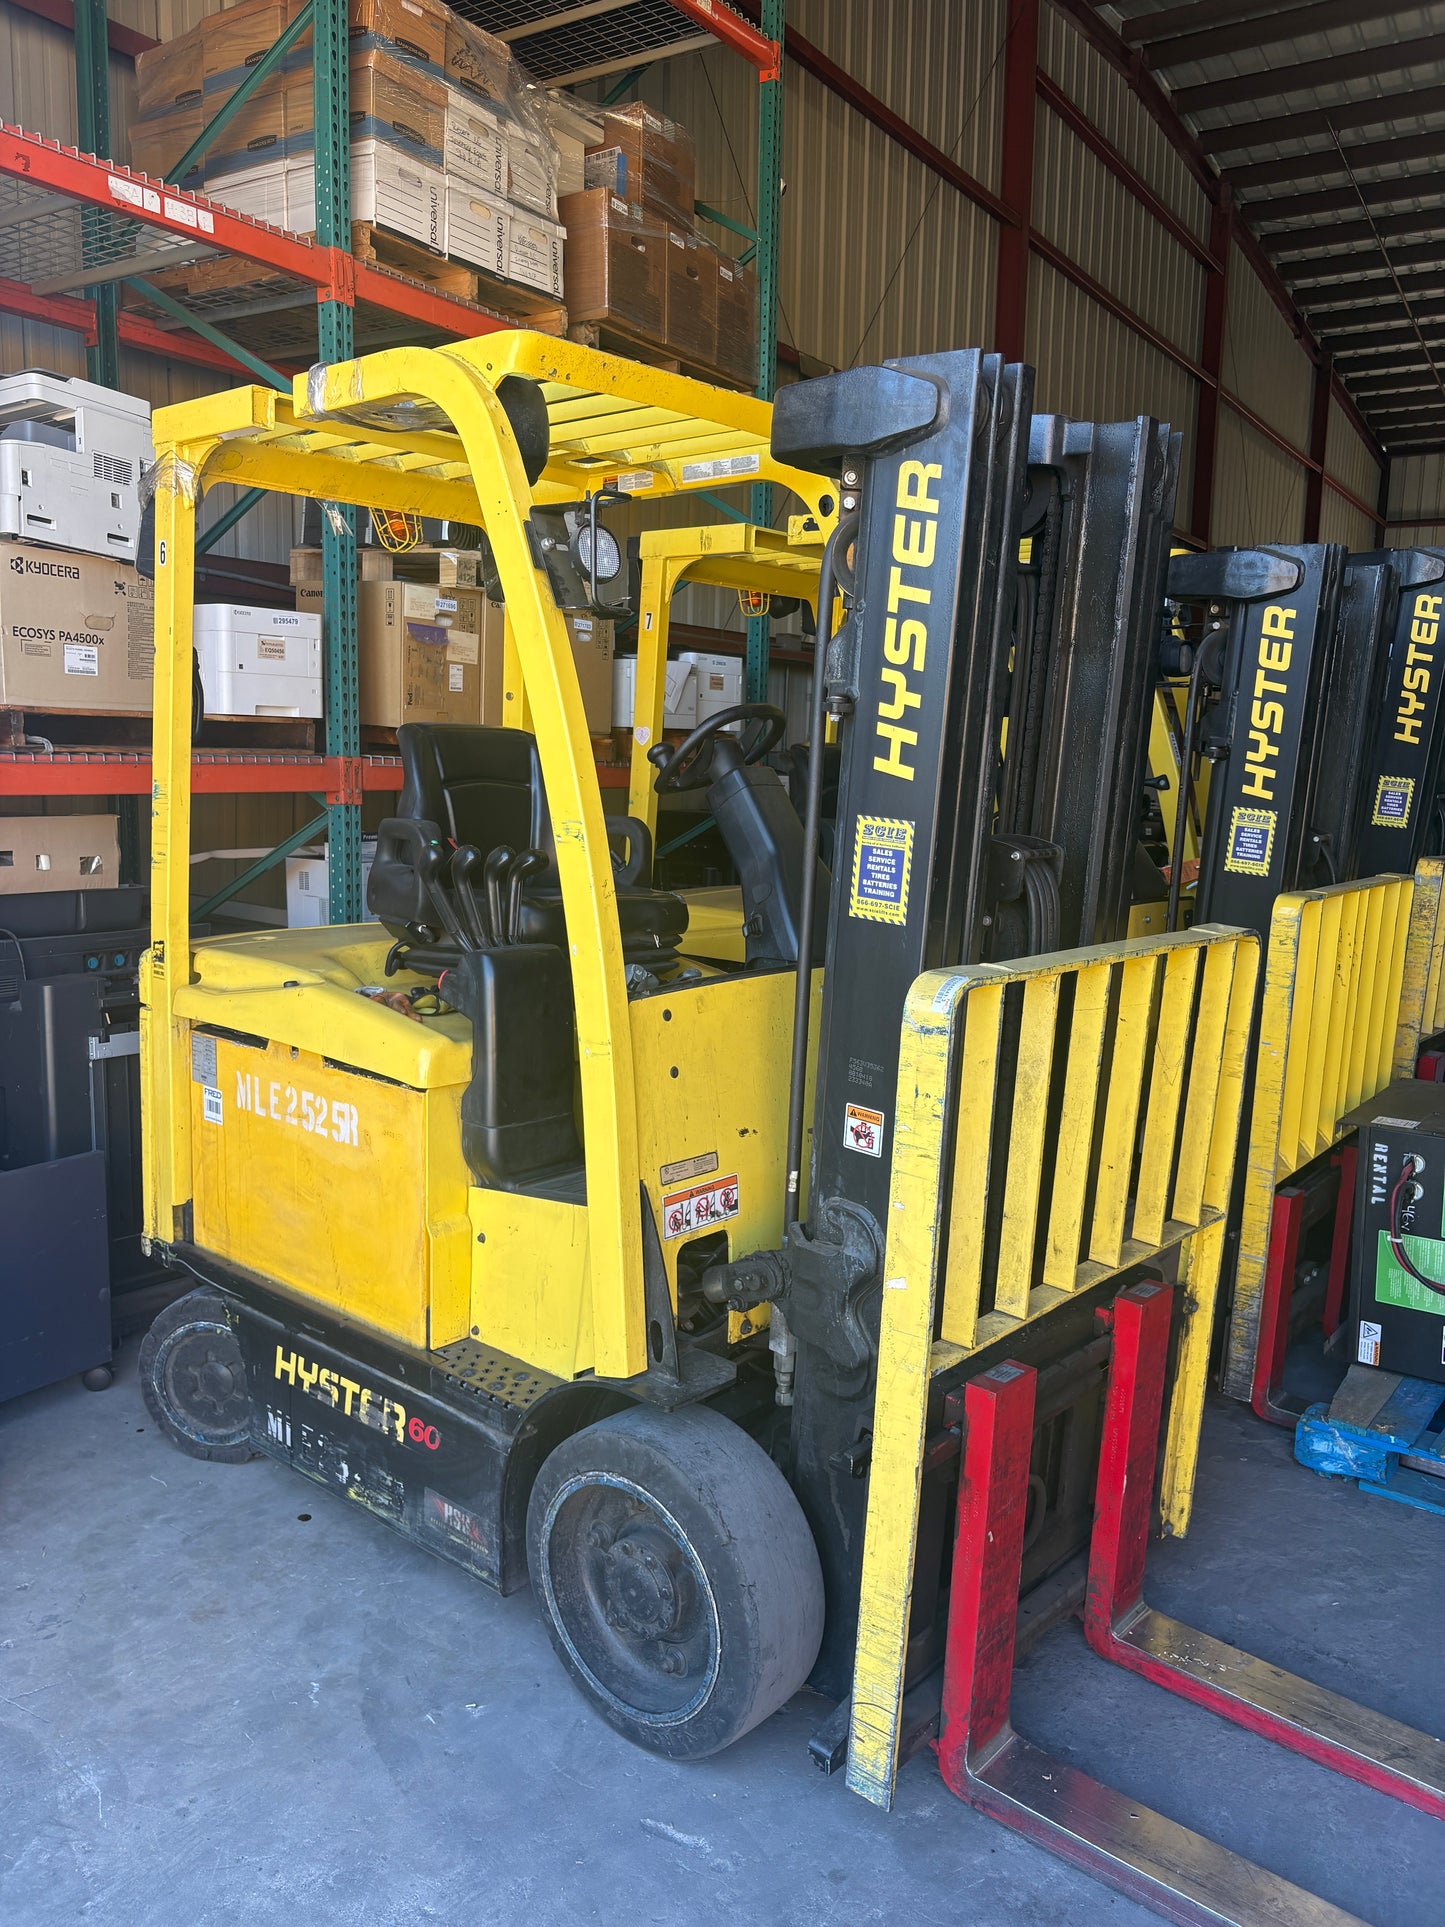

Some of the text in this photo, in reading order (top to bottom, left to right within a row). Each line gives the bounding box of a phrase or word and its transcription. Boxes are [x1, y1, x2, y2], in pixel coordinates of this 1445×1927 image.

[494, 137, 503, 194] universal
[545, 166, 553, 216] universa
[429, 186, 439, 246] universal
[496, 216, 505, 273] universal
[552, 241, 561, 297] universal
[159, 541, 166, 565] 6
[25, 559, 80, 580] KYOCERA
[278, 617, 299, 625] 295479
[645, 613, 652, 630] 7
[872, 460, 943, 781] HYSTER
[12, 626, 105, 646] ECOSYS PA4500x
[1393, 594, 1443, 745] HYSTER
[1241, 605, 1297, 800] HYSTER
[1238, 812, 1271, 823] SCIE
[863, 823, 907, 840] SCIE
[868, 856, 897, 865] SERVICE
[872, 848, 893, 857] SALES
[1236, 852, 1261, 860] TRAINING
[866, 864, 896, 873] RENTALS
[871, 872, 890, 881] TIRES
[862, 879, 898, 890] BATTERIES
[863, 887, 895, 898] TRAINING
[856, 898, 900, 911] 866-697-SCIE
[204, 1087, 222, 1100] FRED
[857, 1111, 880, 1122] WARNING
[1371, 1142, 1389, 1205] RENTAL
[695, 1184, 715, 1196] WARNING
[408, 1416, 441, 1451] 60
